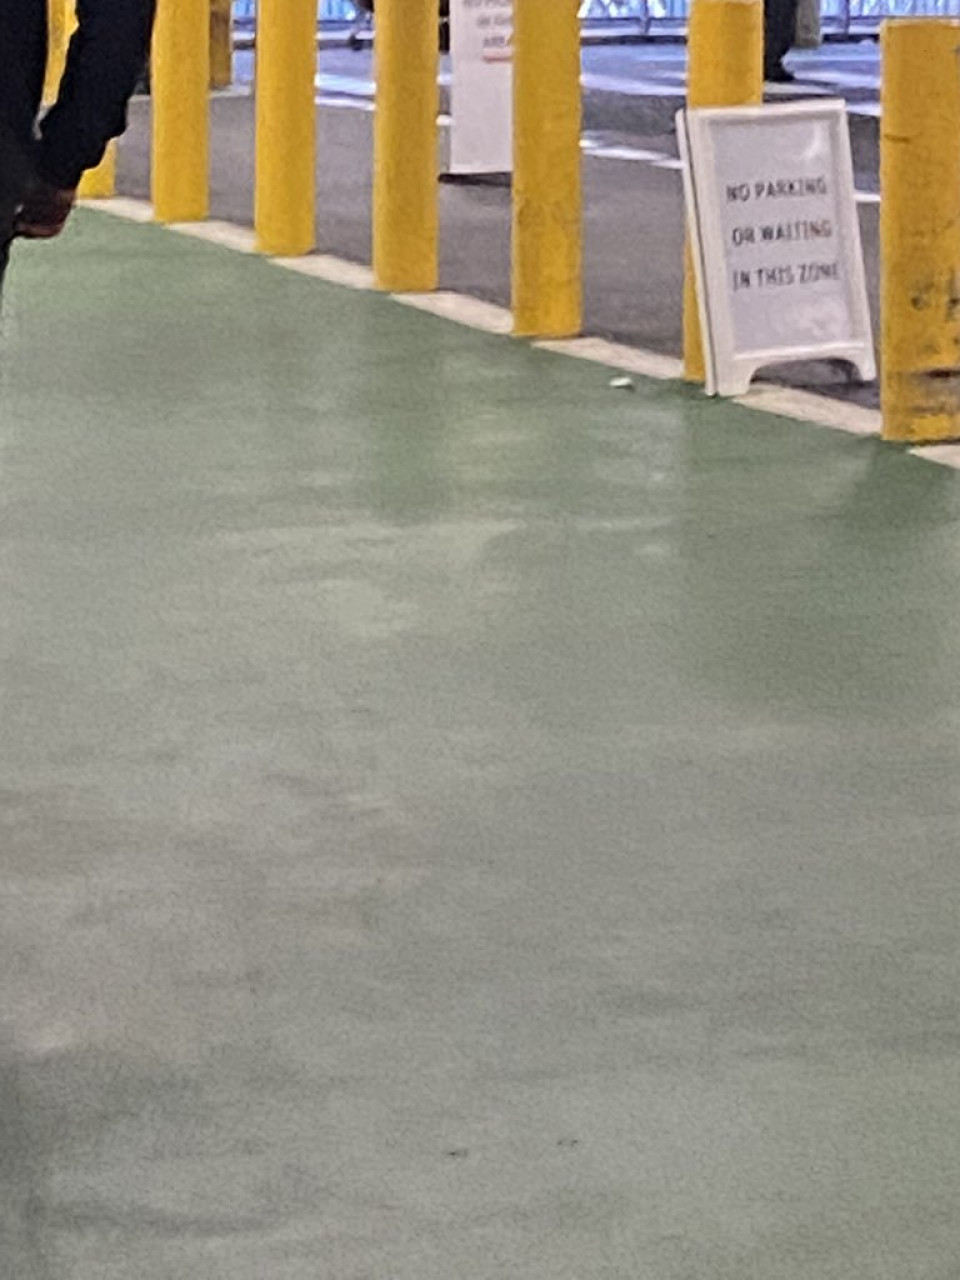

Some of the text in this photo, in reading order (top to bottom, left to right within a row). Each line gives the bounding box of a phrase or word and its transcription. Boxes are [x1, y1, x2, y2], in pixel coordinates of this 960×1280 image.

[726, 175, 827, 202] NO PARKING
[732, 219, 832, 246] OR WAITING
[733, 262, 839, 291] IN THIS ZONE
